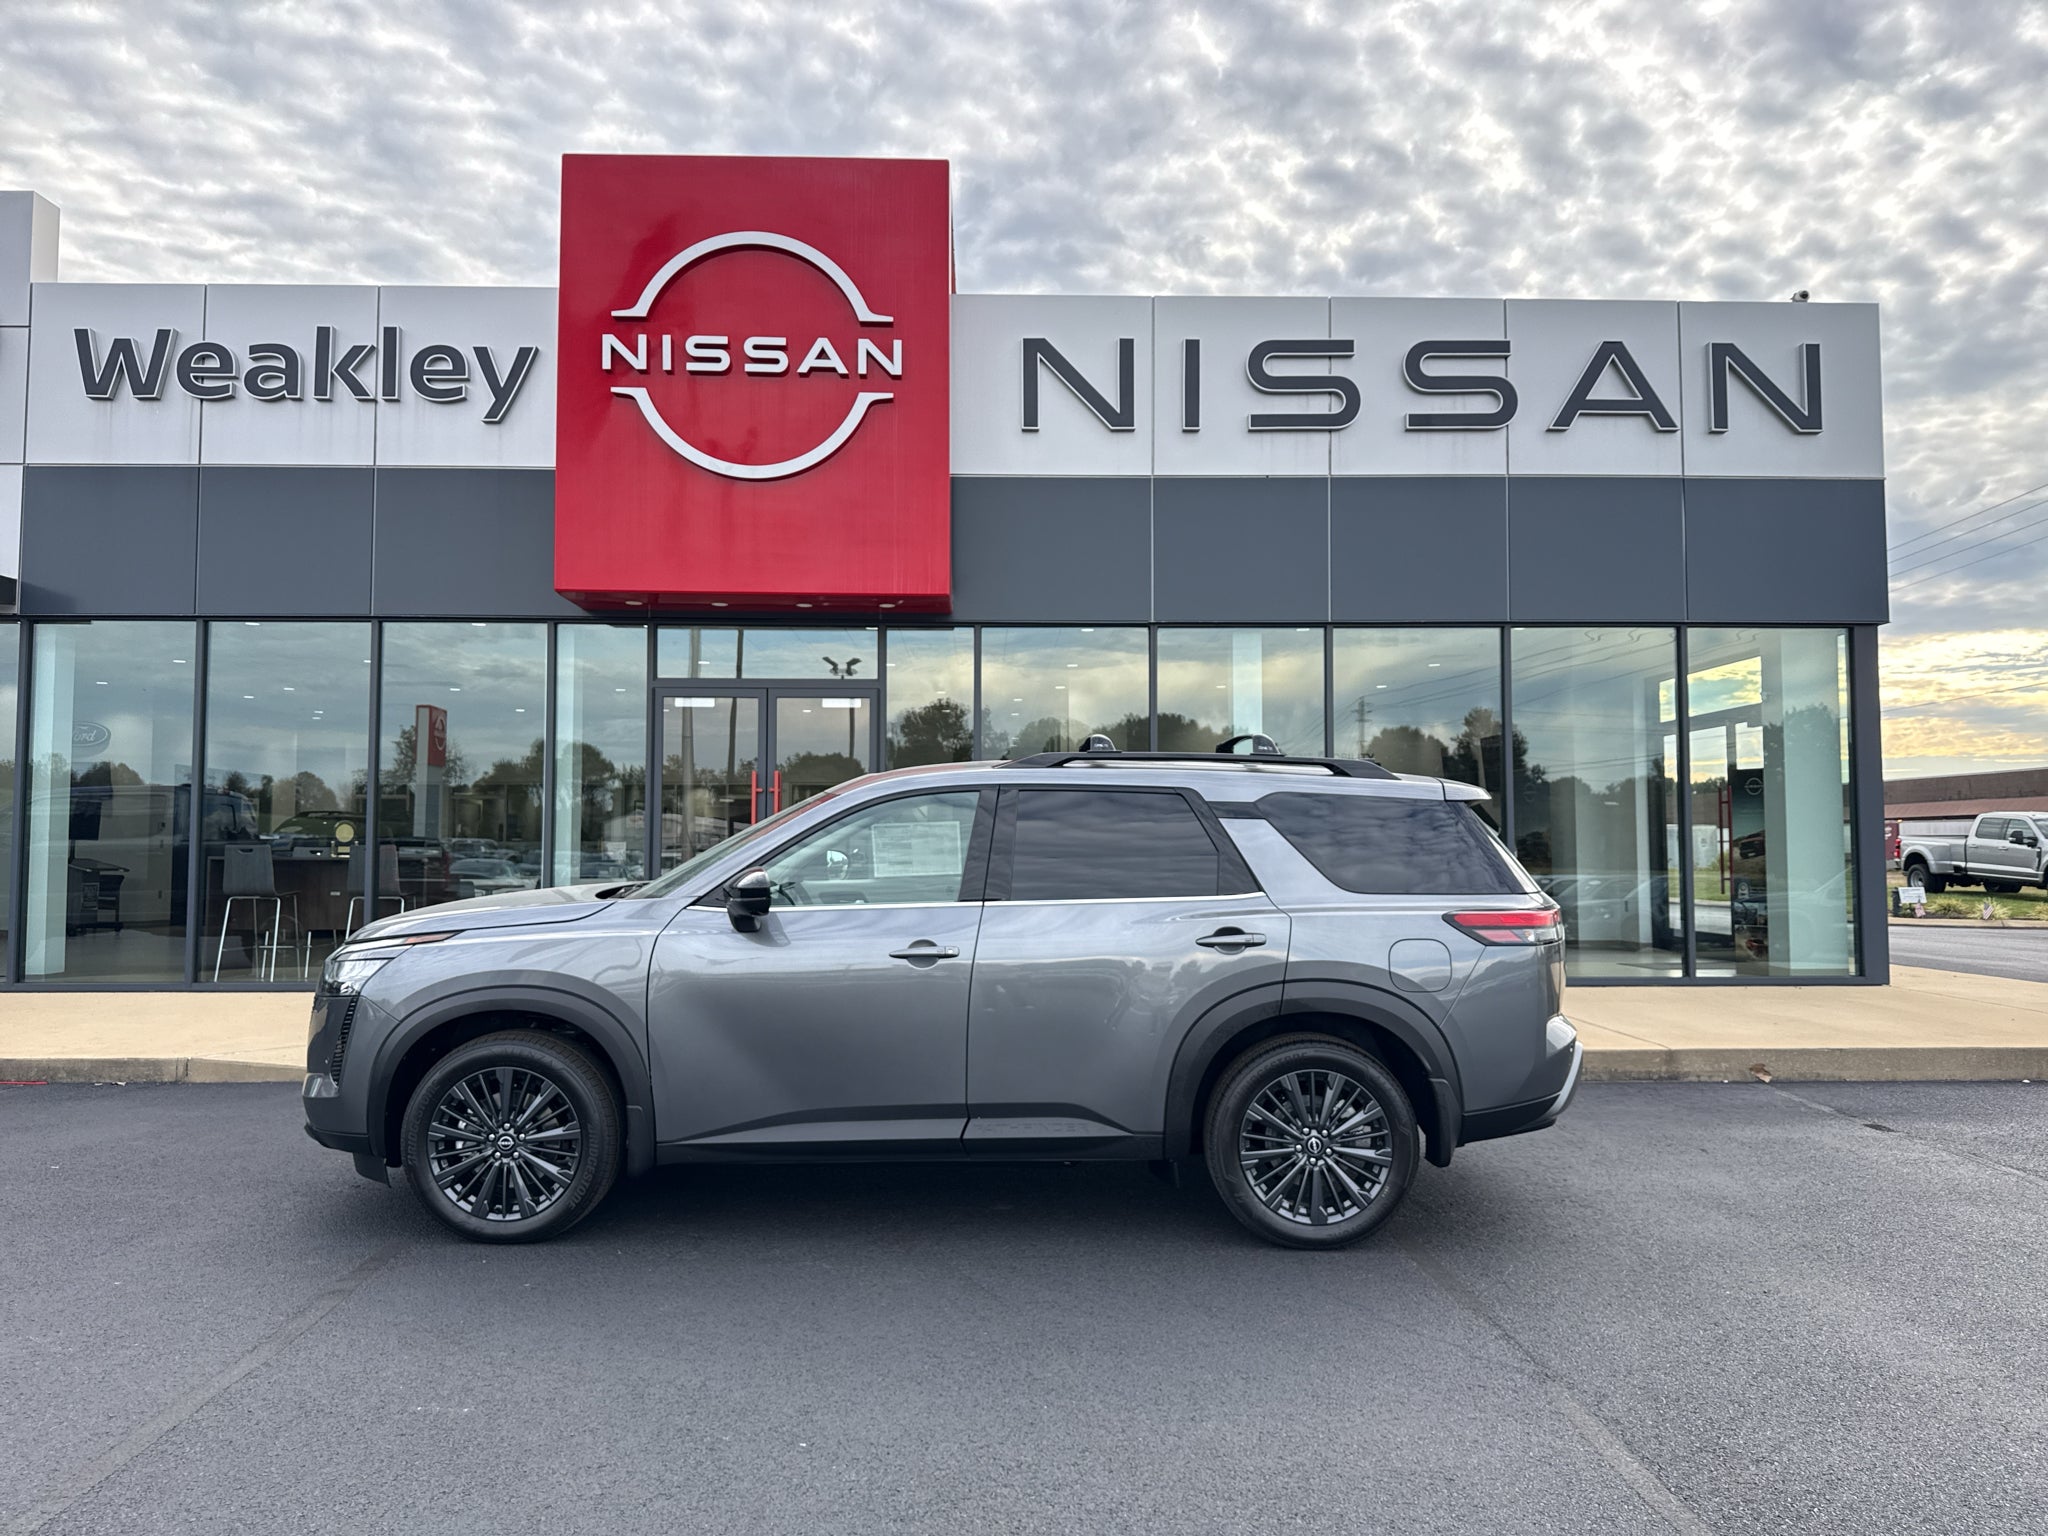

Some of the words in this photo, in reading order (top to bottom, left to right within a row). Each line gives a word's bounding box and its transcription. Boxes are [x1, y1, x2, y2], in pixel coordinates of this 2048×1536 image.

[73, 325, 539, 424] Weakley
[602, 334, 902, 376] NISSAN
[1021, 338, 1824, 434] NISSAN
